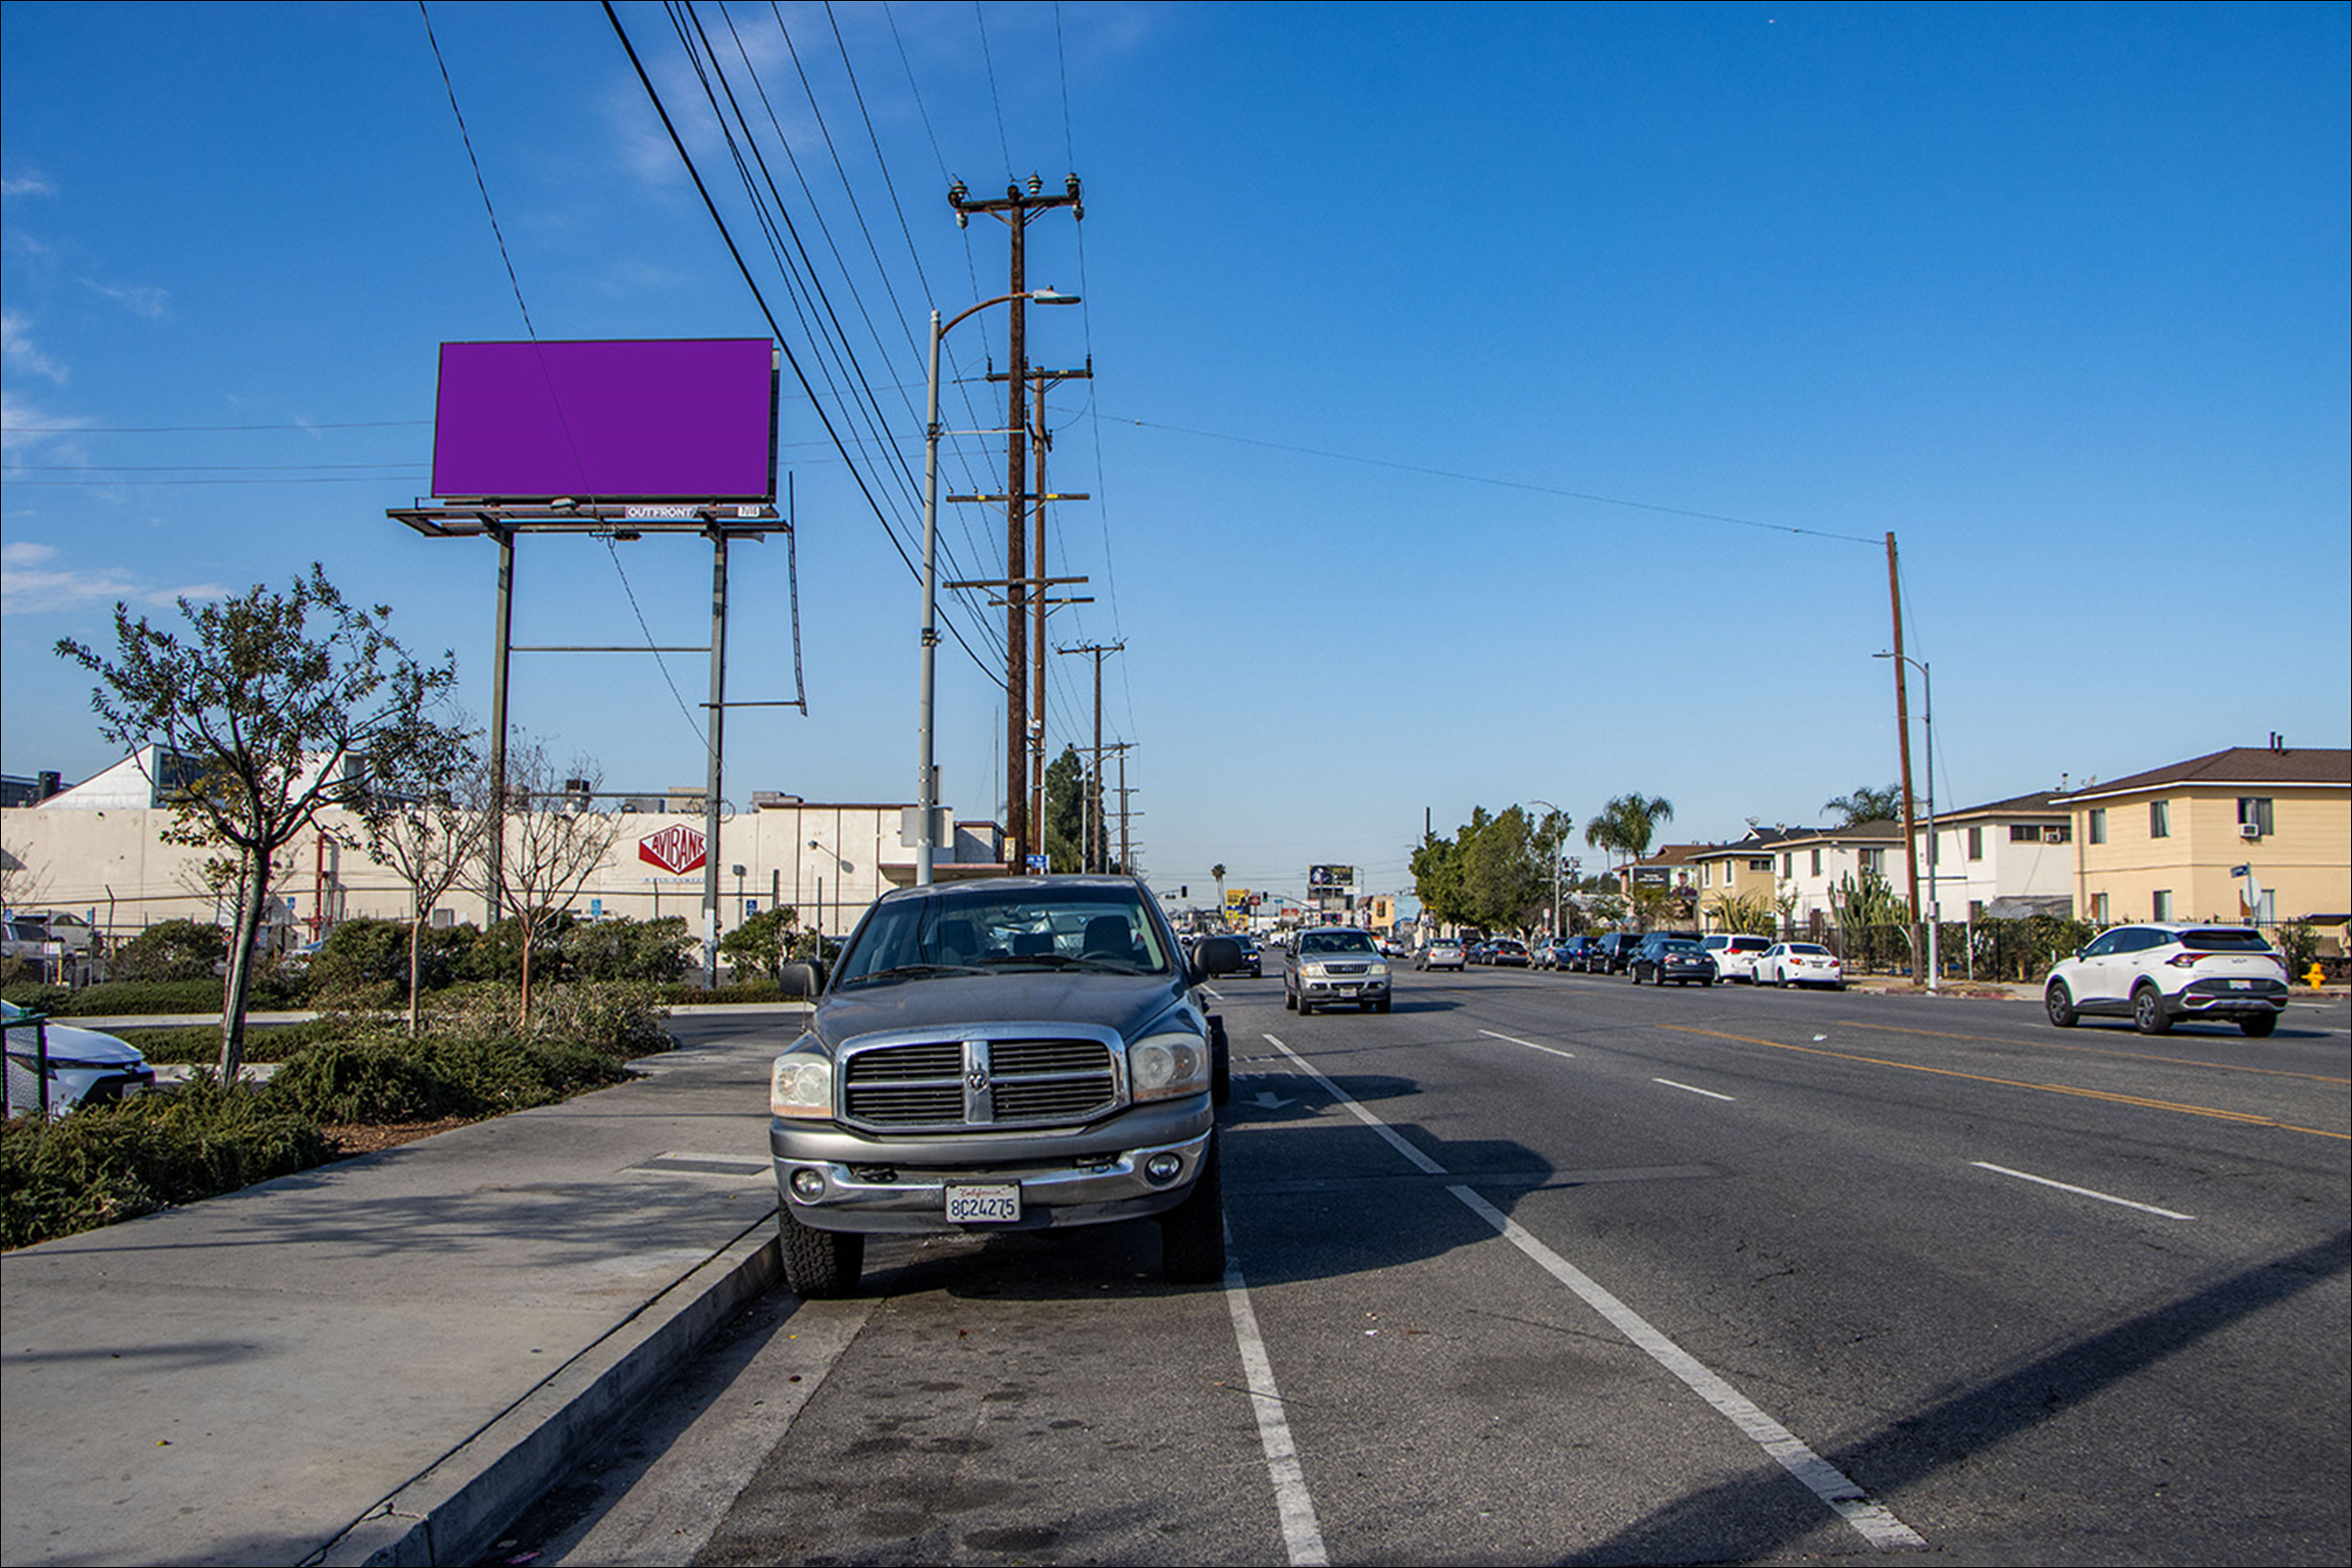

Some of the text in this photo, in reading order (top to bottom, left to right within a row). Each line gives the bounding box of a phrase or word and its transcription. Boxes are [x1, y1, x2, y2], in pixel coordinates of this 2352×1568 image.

[627, 506, 694, 518] OUTFRONT
[653, 828, 705, 870] AVIBANK
[960, 1188, 1002, 1198] California
[951, 1198, 1015, 1216] 8C24275
